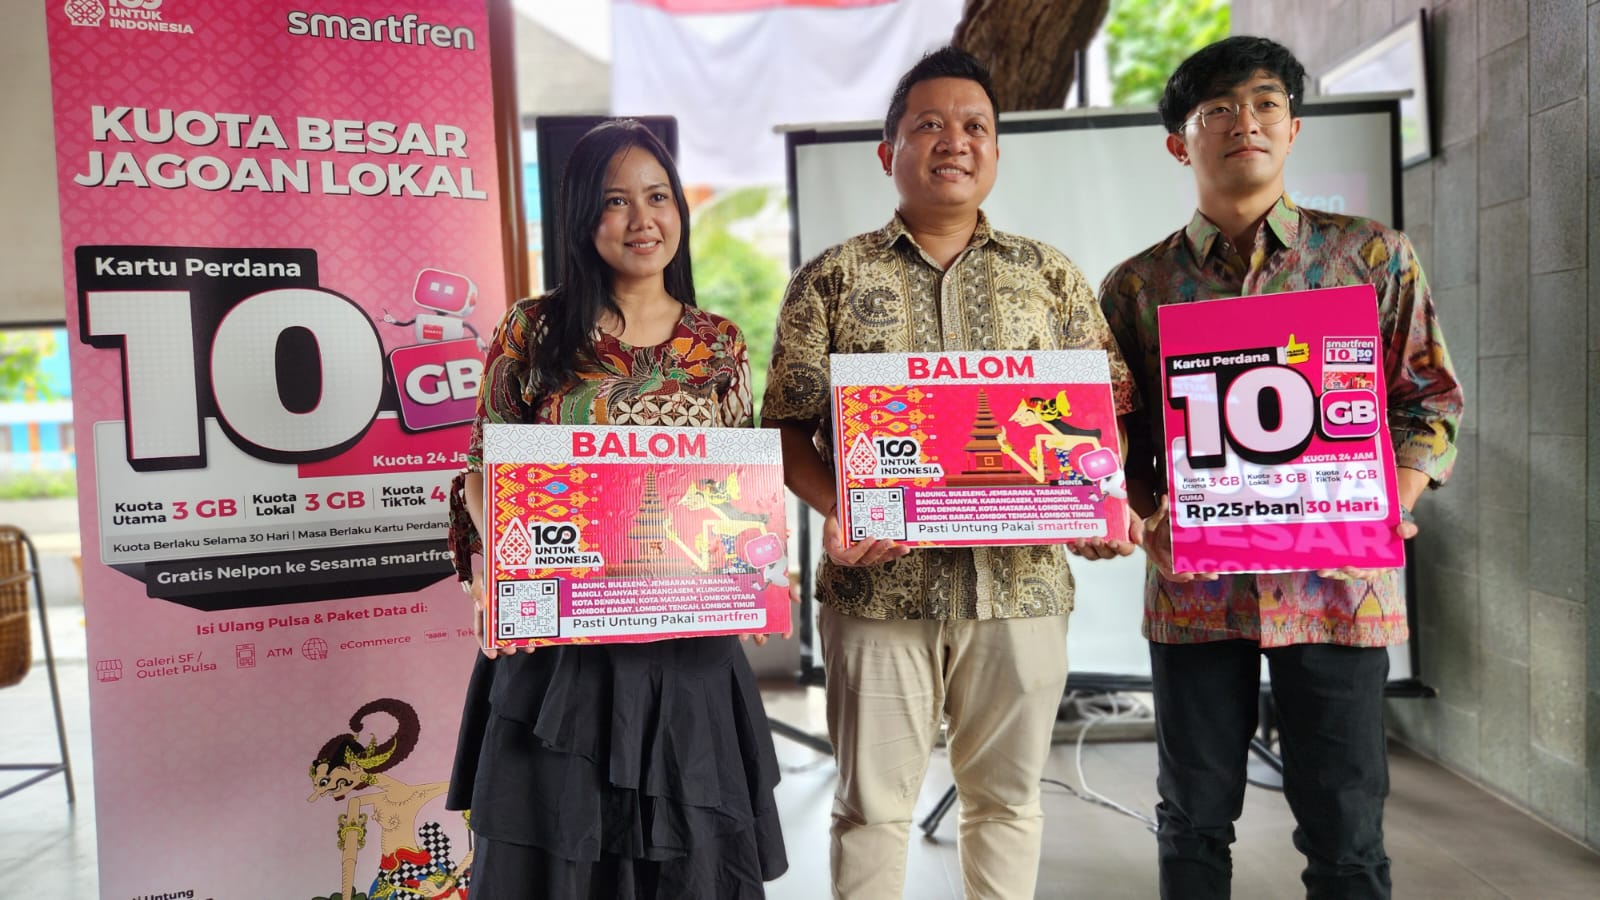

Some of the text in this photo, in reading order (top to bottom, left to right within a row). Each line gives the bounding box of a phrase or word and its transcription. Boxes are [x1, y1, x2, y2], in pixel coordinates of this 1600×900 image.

[109, 8, 162, 20] UNTUK
[109, 19, 194, 34] INDONESIA
[288, 11, 475, 50] smartfren
[91, 105, 468, 158] KUOTA BESAR
[74, 152, 487, 199] JAGOAN LOKAL
[95, 257, 301, 277] Kartu Perdana
[1326, 340, 1374, 348] smartfren
[1173, 357, 1210, 370] Kartu
[1213, 352, 1270, 367] Perdana
[1329, 349, 1350, 361] 10
[86, 288, 385, 460] 10
[907, 356, 1035, 380] BALOM
[405, 358, 483, 404] GB
[1169, 366, 1315, 457] 10
[1326, 400, 1376, 425] GB
[571, 432, 707, 458] BALOM
[373, 452, 468, 467] Kuota 24 Ja
[1303, 452, 1374, 463] KUOTA 24 JAM
[881, 467, 940, 475] INDONESIA
[1274, 472, 1307, 484] 3 GB
[1316, 469, 1340, 477] Kuota
[1343, 469, 1377, 481] 4 GB
[1209, 476, 1240, 487] 3 GB
[1315, 475, 1342, 483] TikTok
[252, 491, 297, 504] Kuota
[383, 485, 424, 496] Kuota
[431, 486, 446, 502] 4
[305, 490, 366, 512] 3 GB
[381, 496, 426, 508] TikTok
[1179, 494, 1204, 502] CUMA
[115, 500, 163, 513] Kuota
[172, 498, 238, 520] 3 GB
[256, 503, 295, 517] Lokal
[1187, 497, 1379, 521] Rp25rban 30 Hari
[113, 511, 166, 526] Utama
[976, 512, 1007, 520] LOMBOK
[919, 520, 1098, 533] Pasti Untung Pakai smartfren
[113, 519, 450, 553] Kuota Berlaku Selama 30 Hari Masa Berlaku Kartu Perdana
[535, 546, 575, 554] UNTUK
[157, 549, 451, 584] Gratis Nelpon ke Sesama smartfre
[535, 556, 600, 564] INDONESIA
[572, 599, 593, 607] KOTA
[197, 603, 428, 636] Isi Ulang Pulsa & Paket Data di:
[573, 611, 758, 628] Pasti Untung Pakai smartfren
[456, 629, 474, 638] Tek
[340, 634, 411, 650] eCommerce
[266, 647, 293, 658] ATM
[136, 655, 176, 668] Galeri
[136, 662, 217, 679] Outlet Pulsa
